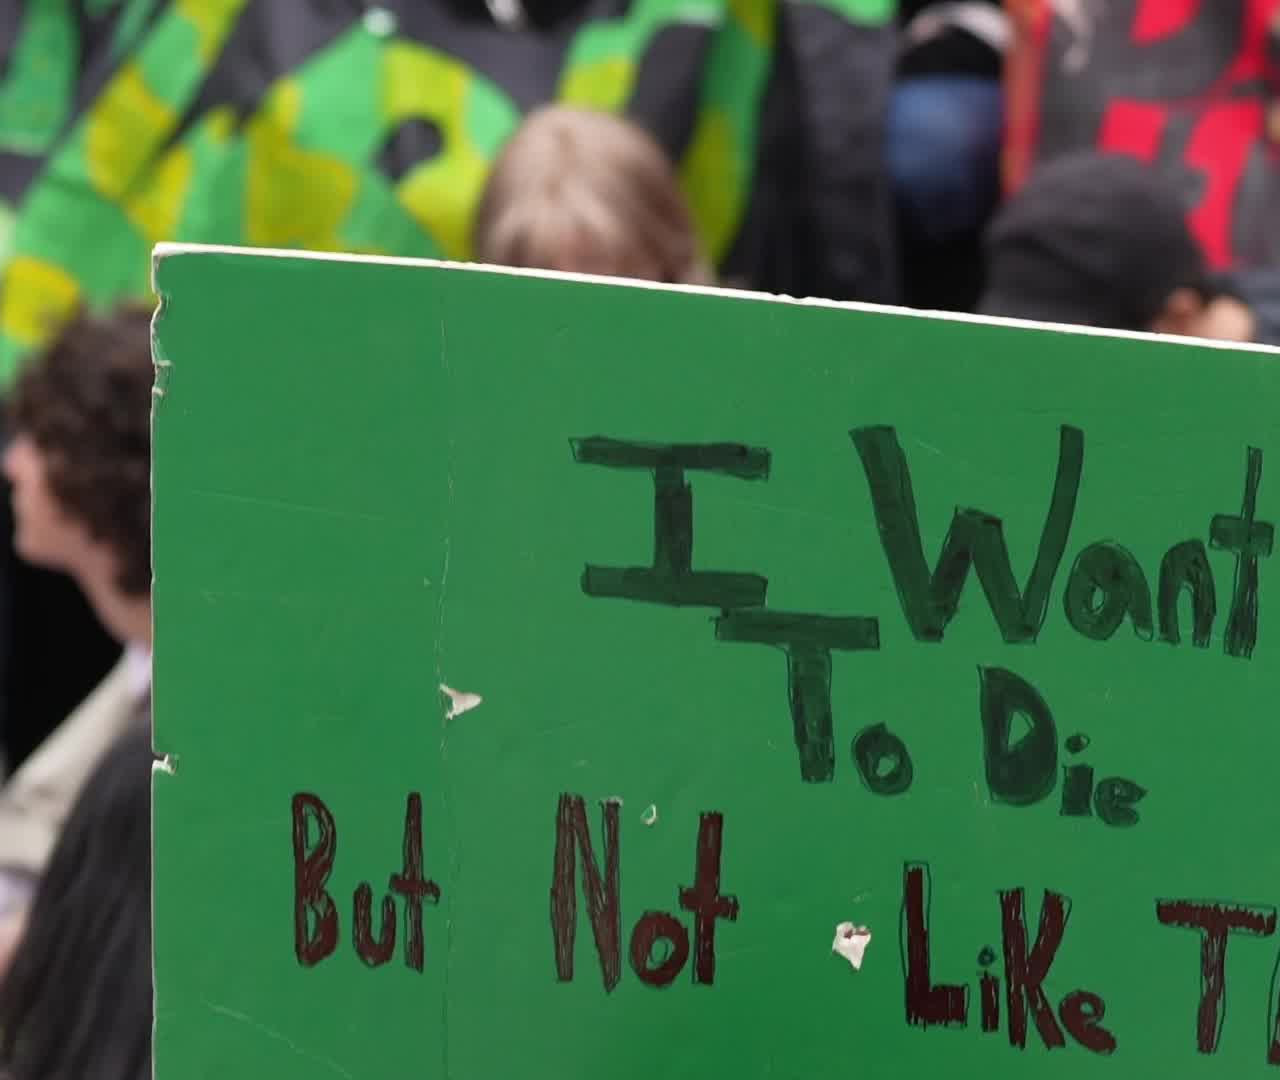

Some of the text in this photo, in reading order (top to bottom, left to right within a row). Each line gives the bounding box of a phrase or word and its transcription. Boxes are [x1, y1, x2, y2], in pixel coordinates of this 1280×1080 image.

[568, 423, 1275, 659] I Want
[713, 605, 1148, 829] To Die
[292, 791, 441, 975] But
[549, 792, 741, 997] Not
